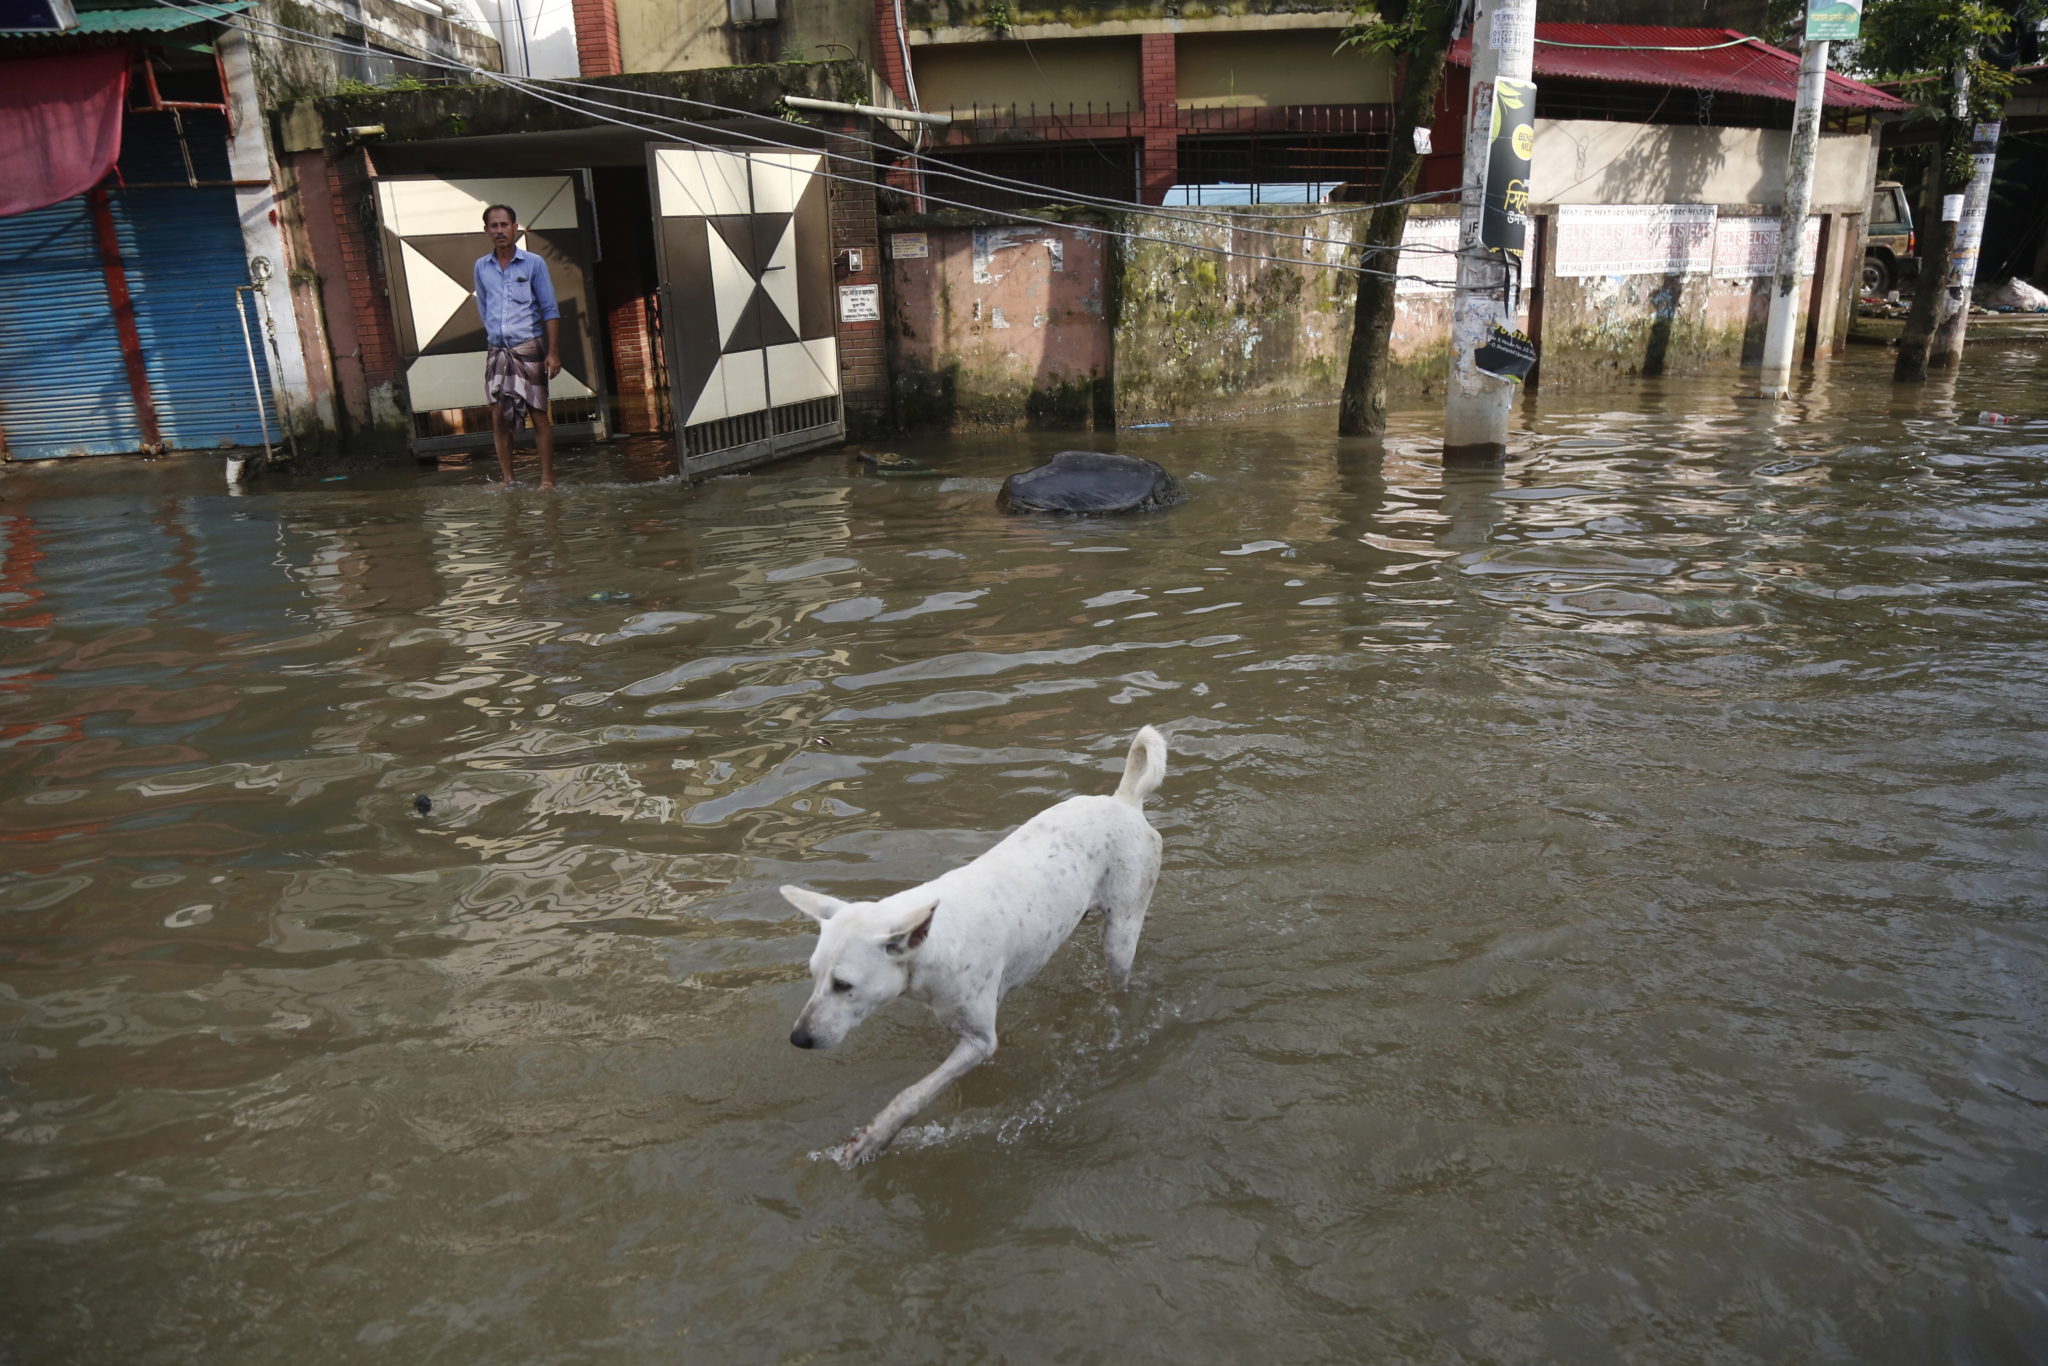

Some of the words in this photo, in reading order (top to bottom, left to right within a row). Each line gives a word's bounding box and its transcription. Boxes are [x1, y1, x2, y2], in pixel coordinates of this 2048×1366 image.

[1560, 224, 1592, 239] IELTS
[1594, 224, 1624, 239] IELTS
[1626, 224, 1654, 238] IELTS
[1657, 224, 1685, 237] IELTS
[1686, 224, 1714, 237] IELTS
[1718, 232, 1744, 244] IELTS
[1745, 231, 1770, 244] IELTS
